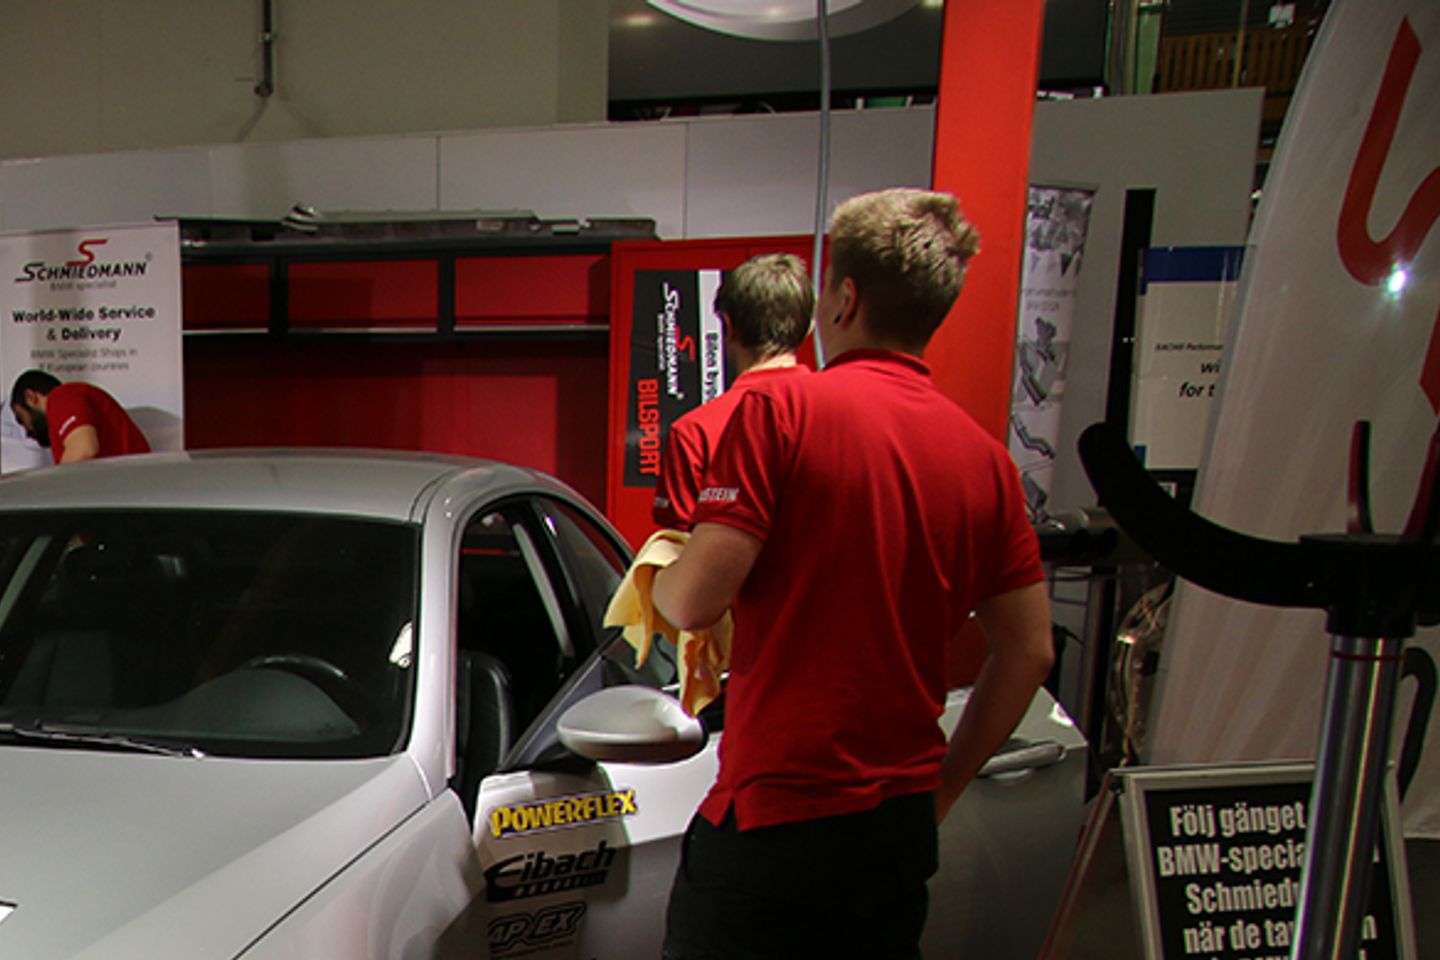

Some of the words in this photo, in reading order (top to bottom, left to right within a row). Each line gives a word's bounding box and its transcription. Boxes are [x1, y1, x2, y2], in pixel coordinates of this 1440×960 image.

[12, 308, 95, 324] World-Wide
[98, 304, 156, 321] Service
[46, 328, 58, 342] &
[62, 326, 122, 343] Delivery
[1179, 382, 1205, 398] for
[636, 378, 660, 477] BILSPORT
[491, 789, 639, 839] POWERFLEX
[1168, 803, 1218, 839] Följ
[1218, 801, 1307, 838] gänget
[484, 840, 617, 886] Eibach
[1182, 920, 1226, 955] när
[1229, 918, 1261, 950] de
